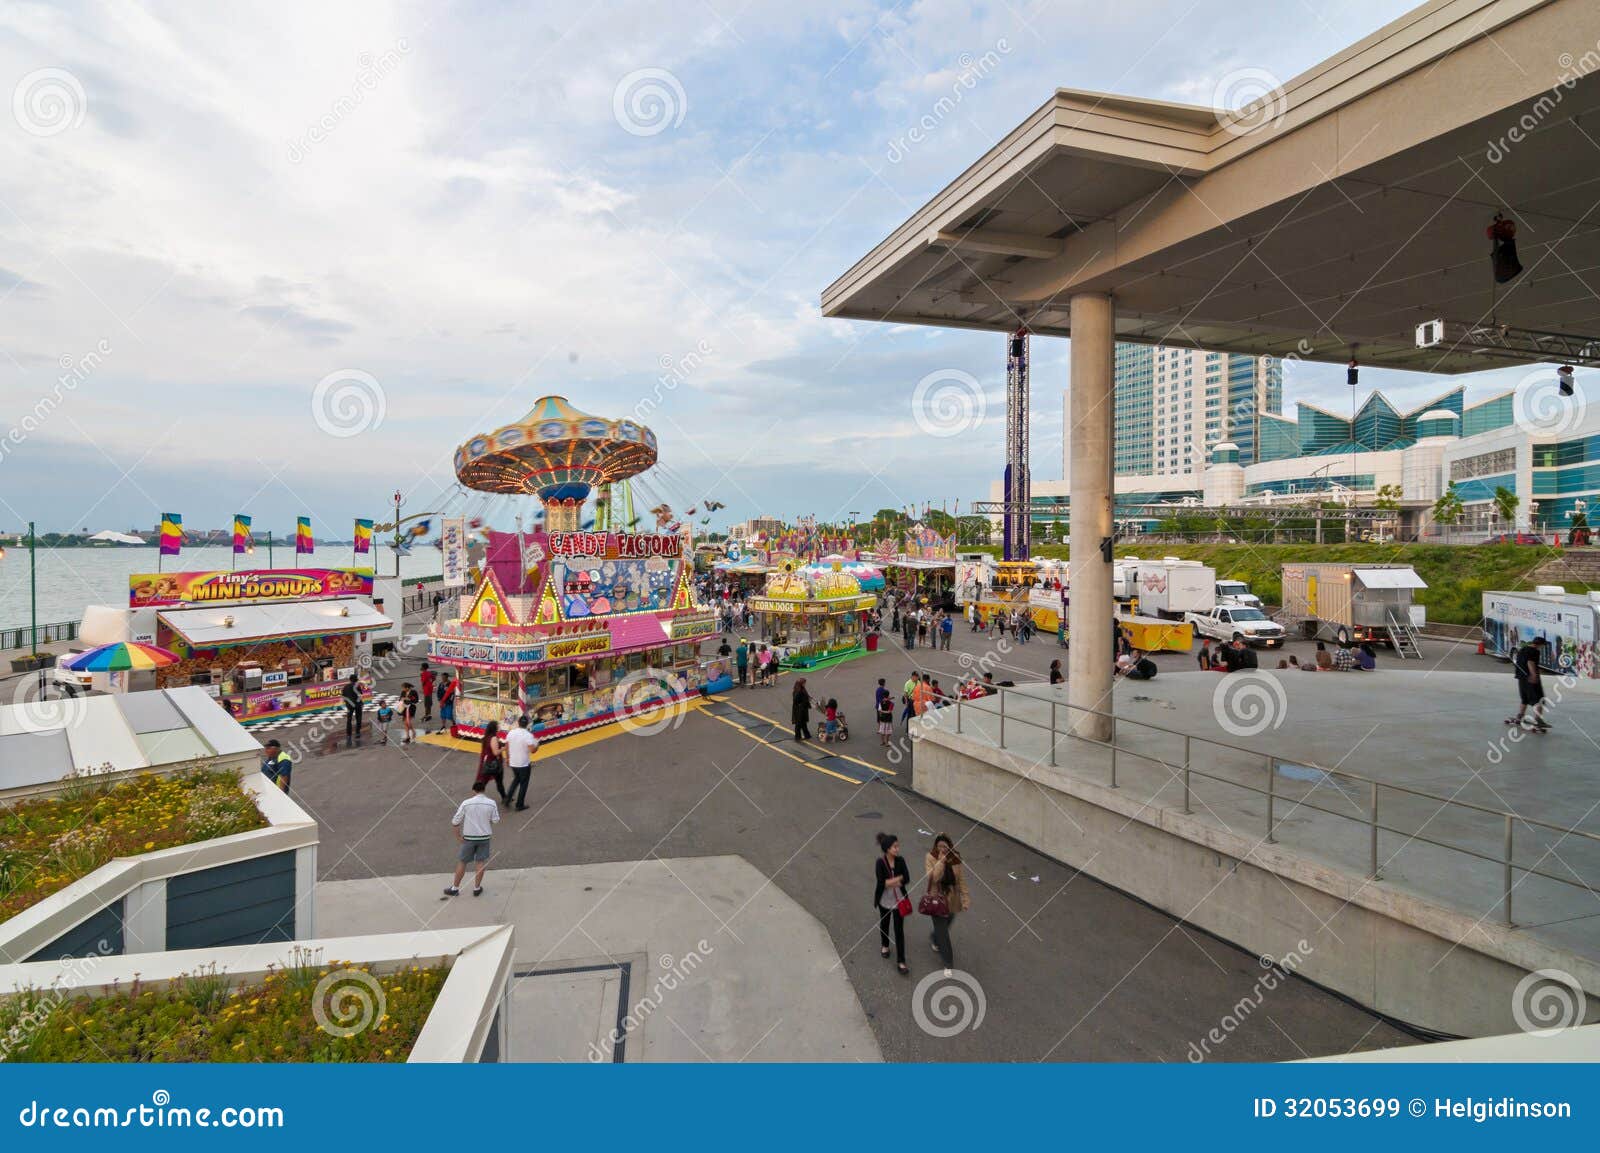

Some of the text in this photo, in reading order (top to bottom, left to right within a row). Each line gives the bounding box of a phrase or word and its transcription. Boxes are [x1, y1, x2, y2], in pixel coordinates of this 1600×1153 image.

[549, 530, 608, 557] CANDY
[616, 533, 680, 558] FACTORY
[217, 573, 259, 585] Tiny's
[192, 579, 323, 601] MINI DONUTS
[754, 601, 774, 611] CORN
[775, 602, 794, 612] DOGS
[468, 646, 491, 660] CANDY
[550, 638, 608, 657] CANDY APPLES
